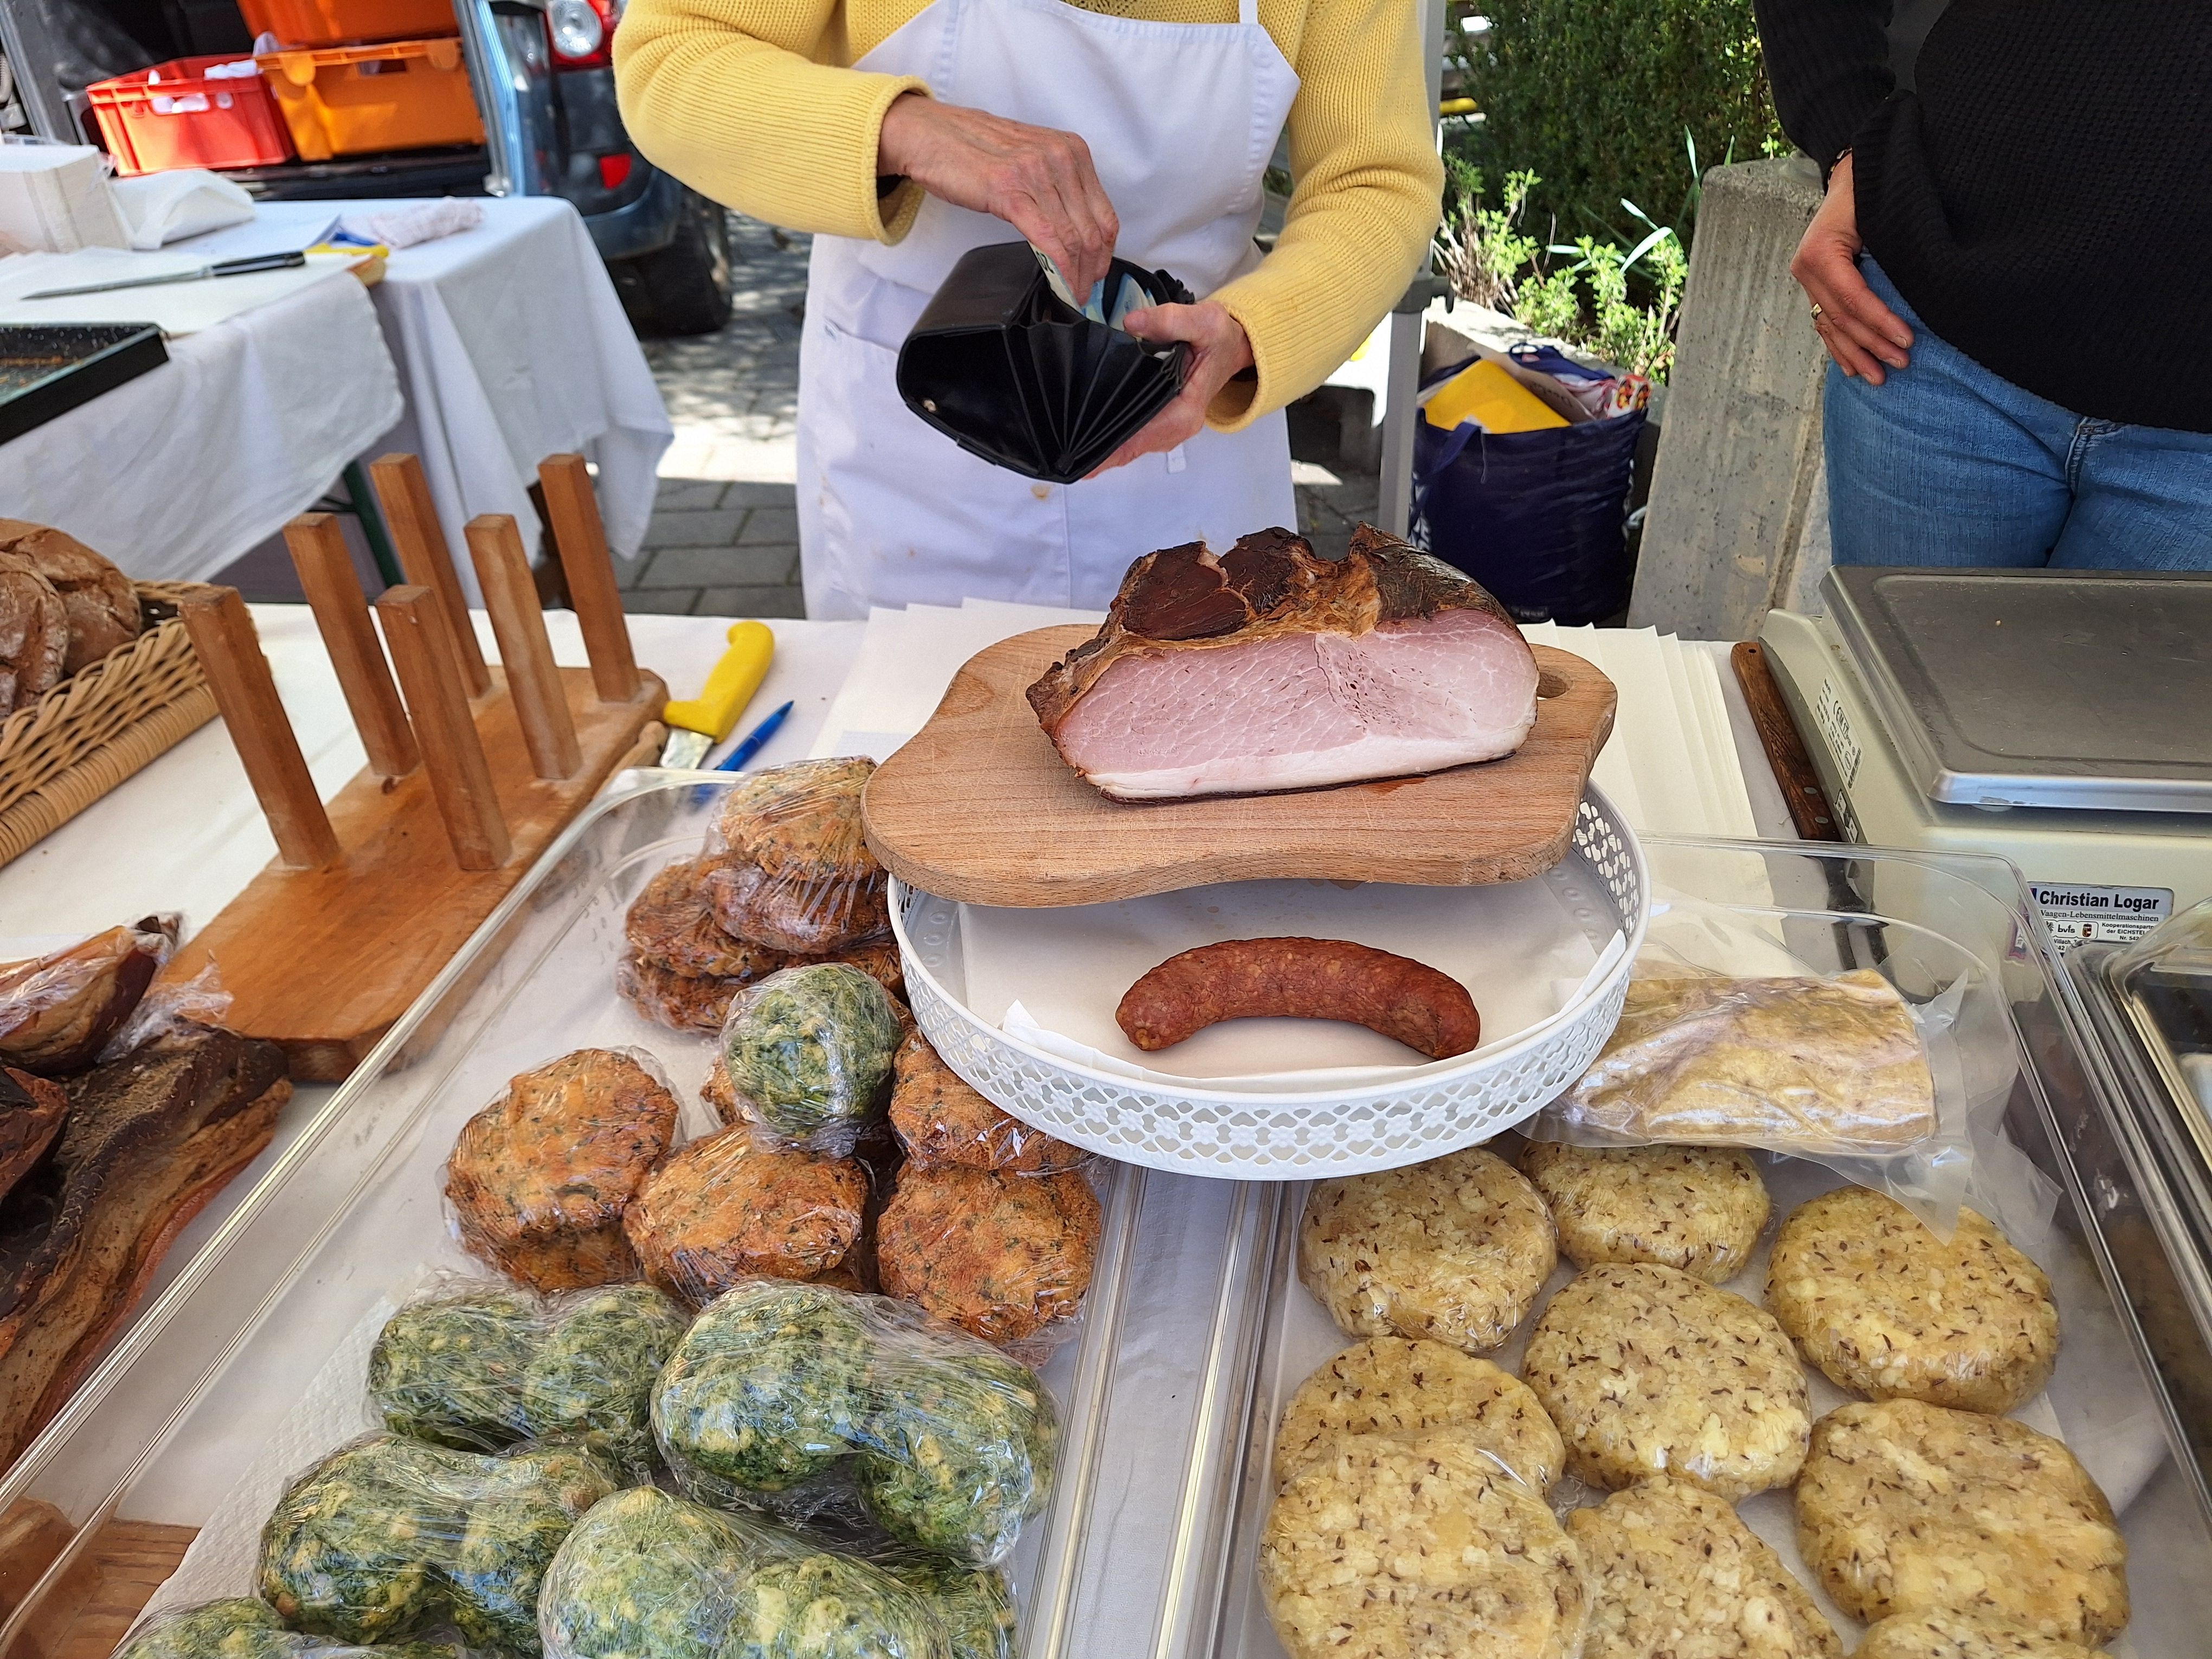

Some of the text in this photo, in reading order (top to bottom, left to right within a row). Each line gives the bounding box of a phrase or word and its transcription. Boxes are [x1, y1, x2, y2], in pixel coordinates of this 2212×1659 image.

[2040, 891, 2159, 912] Christian Logar
[2057, 924, 2075, 933] bvfs
